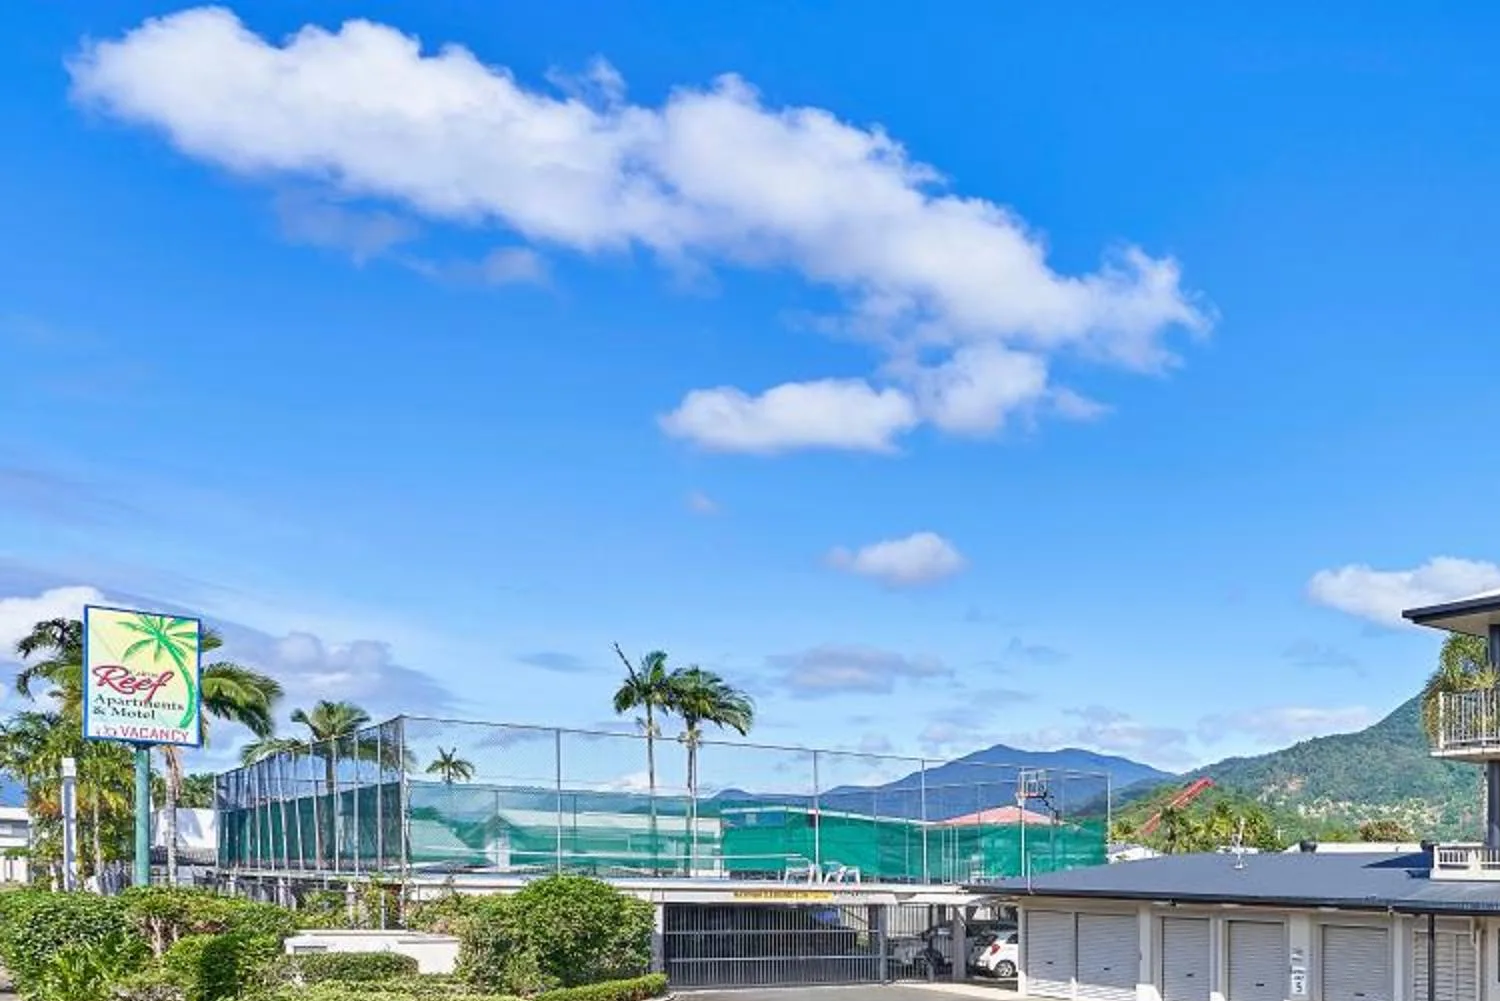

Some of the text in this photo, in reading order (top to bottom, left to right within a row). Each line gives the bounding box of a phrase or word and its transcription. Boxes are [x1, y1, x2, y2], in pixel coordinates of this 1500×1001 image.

[92, 665, 174, 704] Reef
[94, 693, 184, 711] Apartments
[110, 706, 155, 719] Motel
[120, 725, 189, 742] VACANCY
